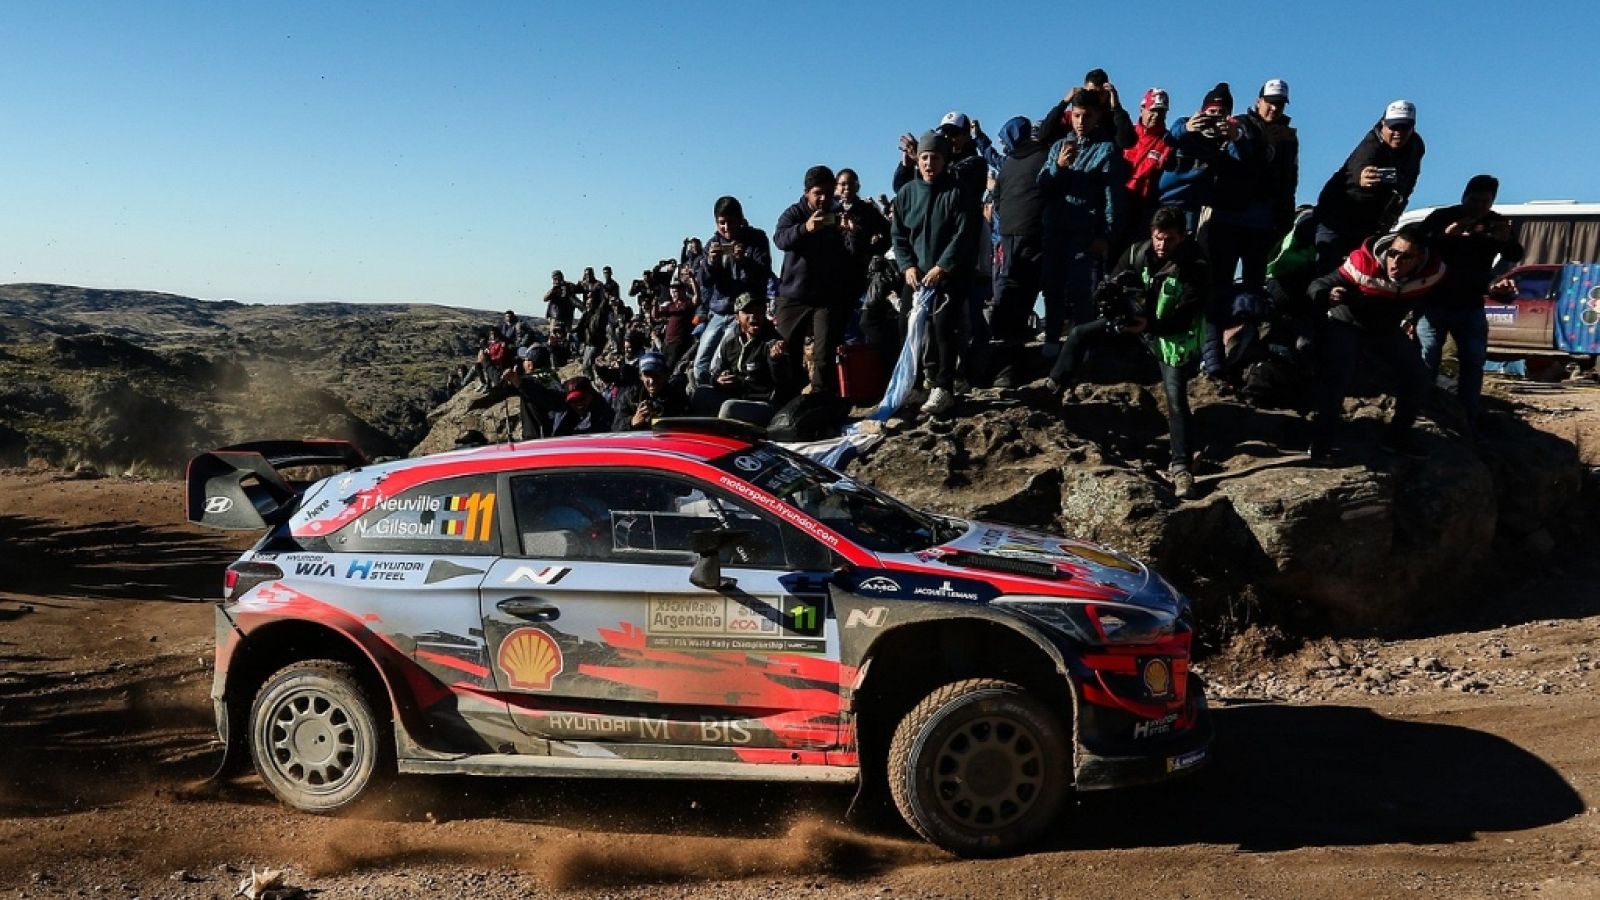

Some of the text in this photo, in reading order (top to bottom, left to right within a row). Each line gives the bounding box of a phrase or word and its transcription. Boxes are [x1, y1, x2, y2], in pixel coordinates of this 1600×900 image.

[360, 495, 440, 511] T. Neuville
[719, 476, 839, 546] motorsport.hyundai.com
[464, 492, 496, 542] 11
[353, 518, 435, 535] N. Gilsoul
[295, 562, 335, 576] WIA
[373, 560, 426, 571] HYUNDAI
[369, 571, 406, 581] STEEL
[653, 612, 722, 629] Argentina
[790, 606, 817, 629] 11
[688, 640, 711, 649] World
[711, 641, 731, 650] Rally
[732, 641, 784, 651] Championship
[548, 715, 633, 732] HYUNDAI
